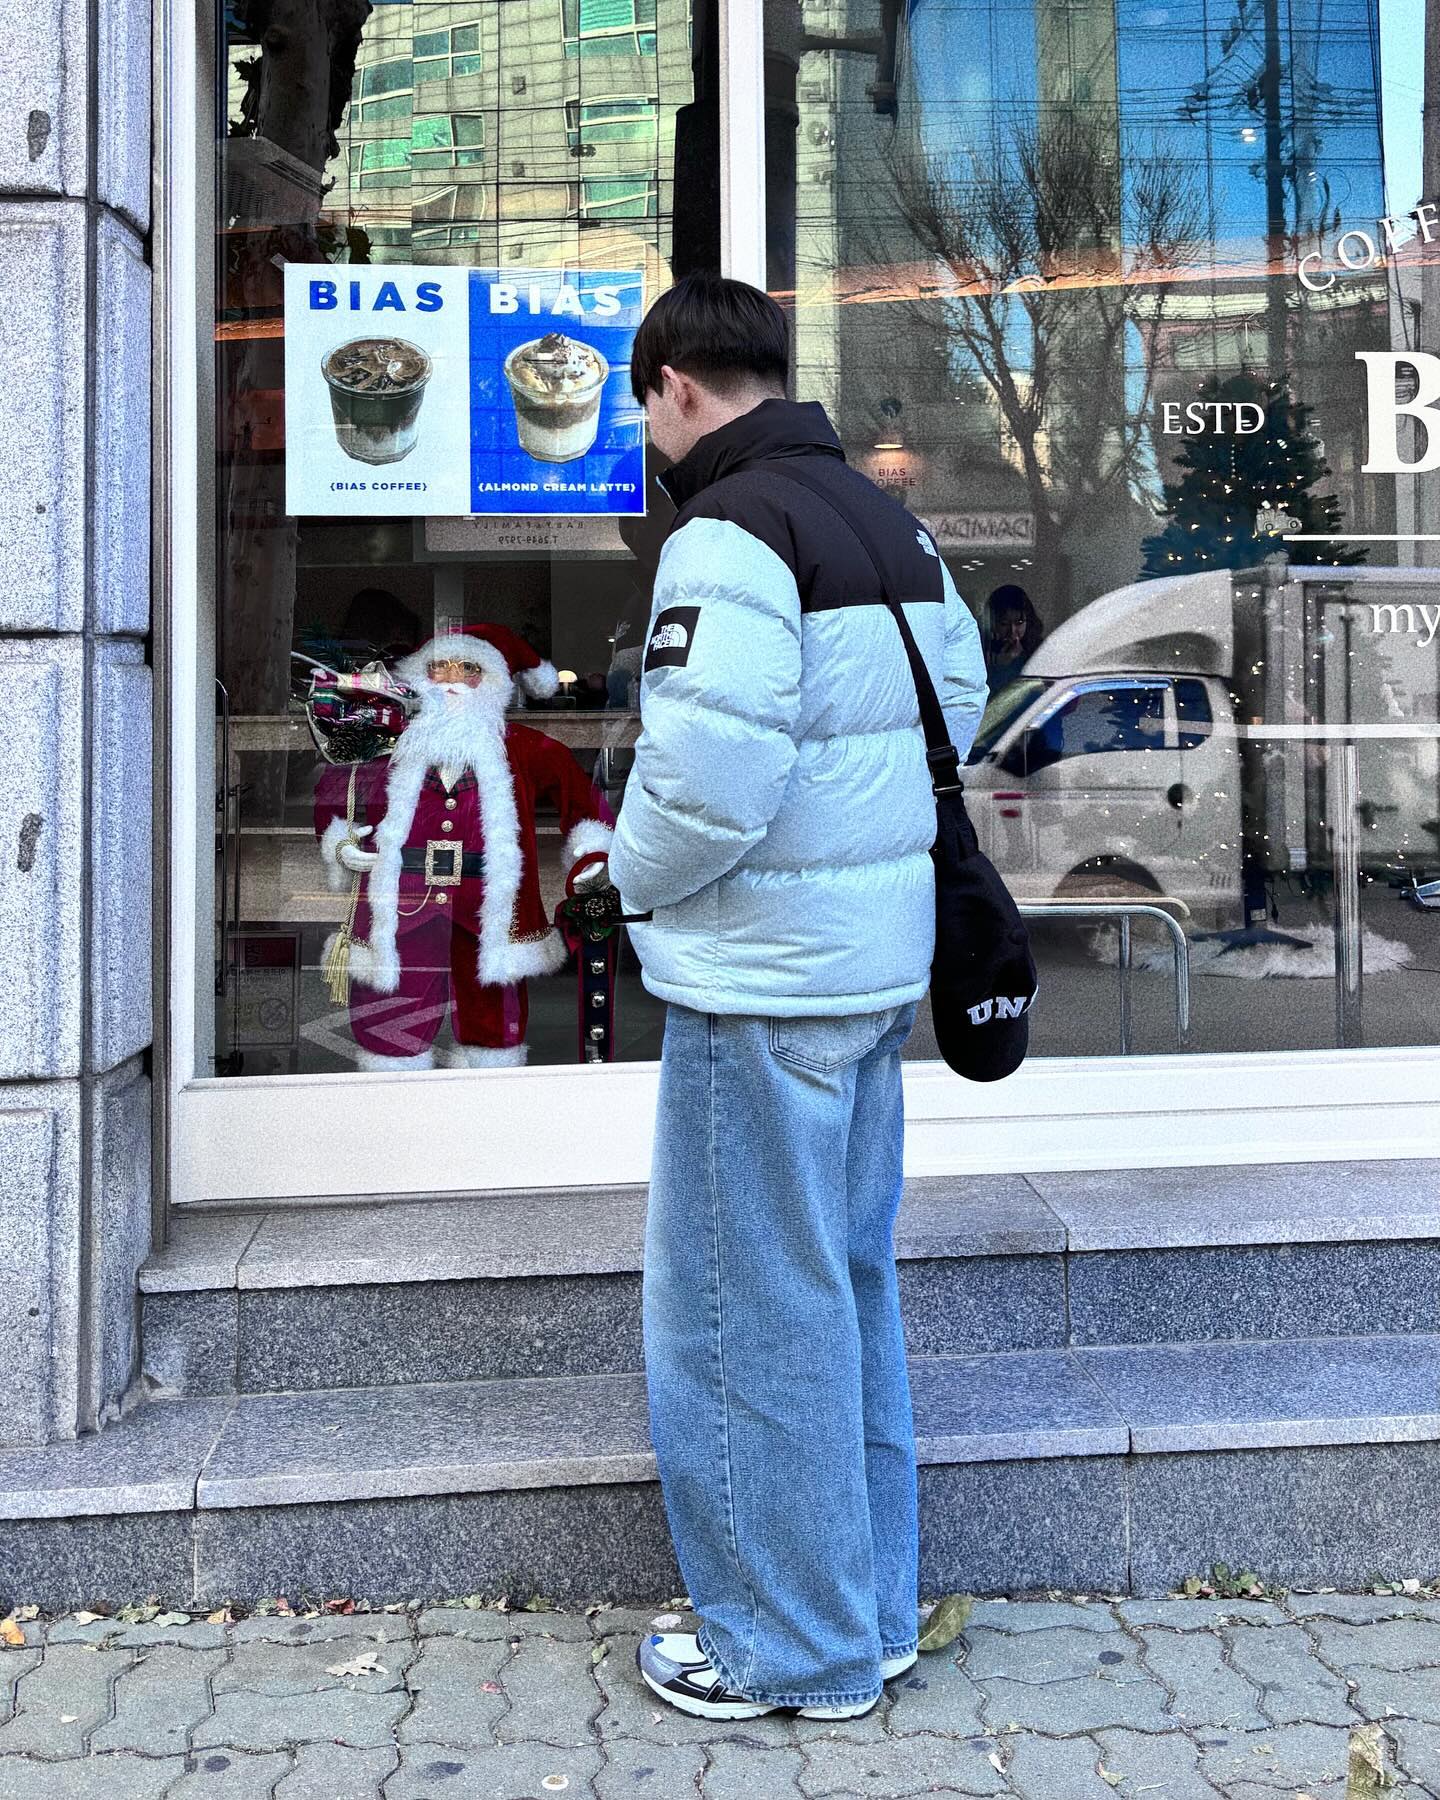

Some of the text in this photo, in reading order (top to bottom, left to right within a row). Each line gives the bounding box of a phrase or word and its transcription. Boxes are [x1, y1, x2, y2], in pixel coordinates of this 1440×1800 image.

[1298, 203, 1439, 291] COFF
[309, 280, 444, 312] BIAS
[489, 283, 622, 316] BIAS
[1161, 402, 1265, 434] ESTD
[1355, 351, 1440, 473] B
[330, 482, 428, 491] {BIAS COFFEE}
[543, 483, 587, 492] CREAM
[876, 477, 917, 488] OFFEE
[878, 468, 906, 477] BIAS
[1369, 604, 1440, 648] my
